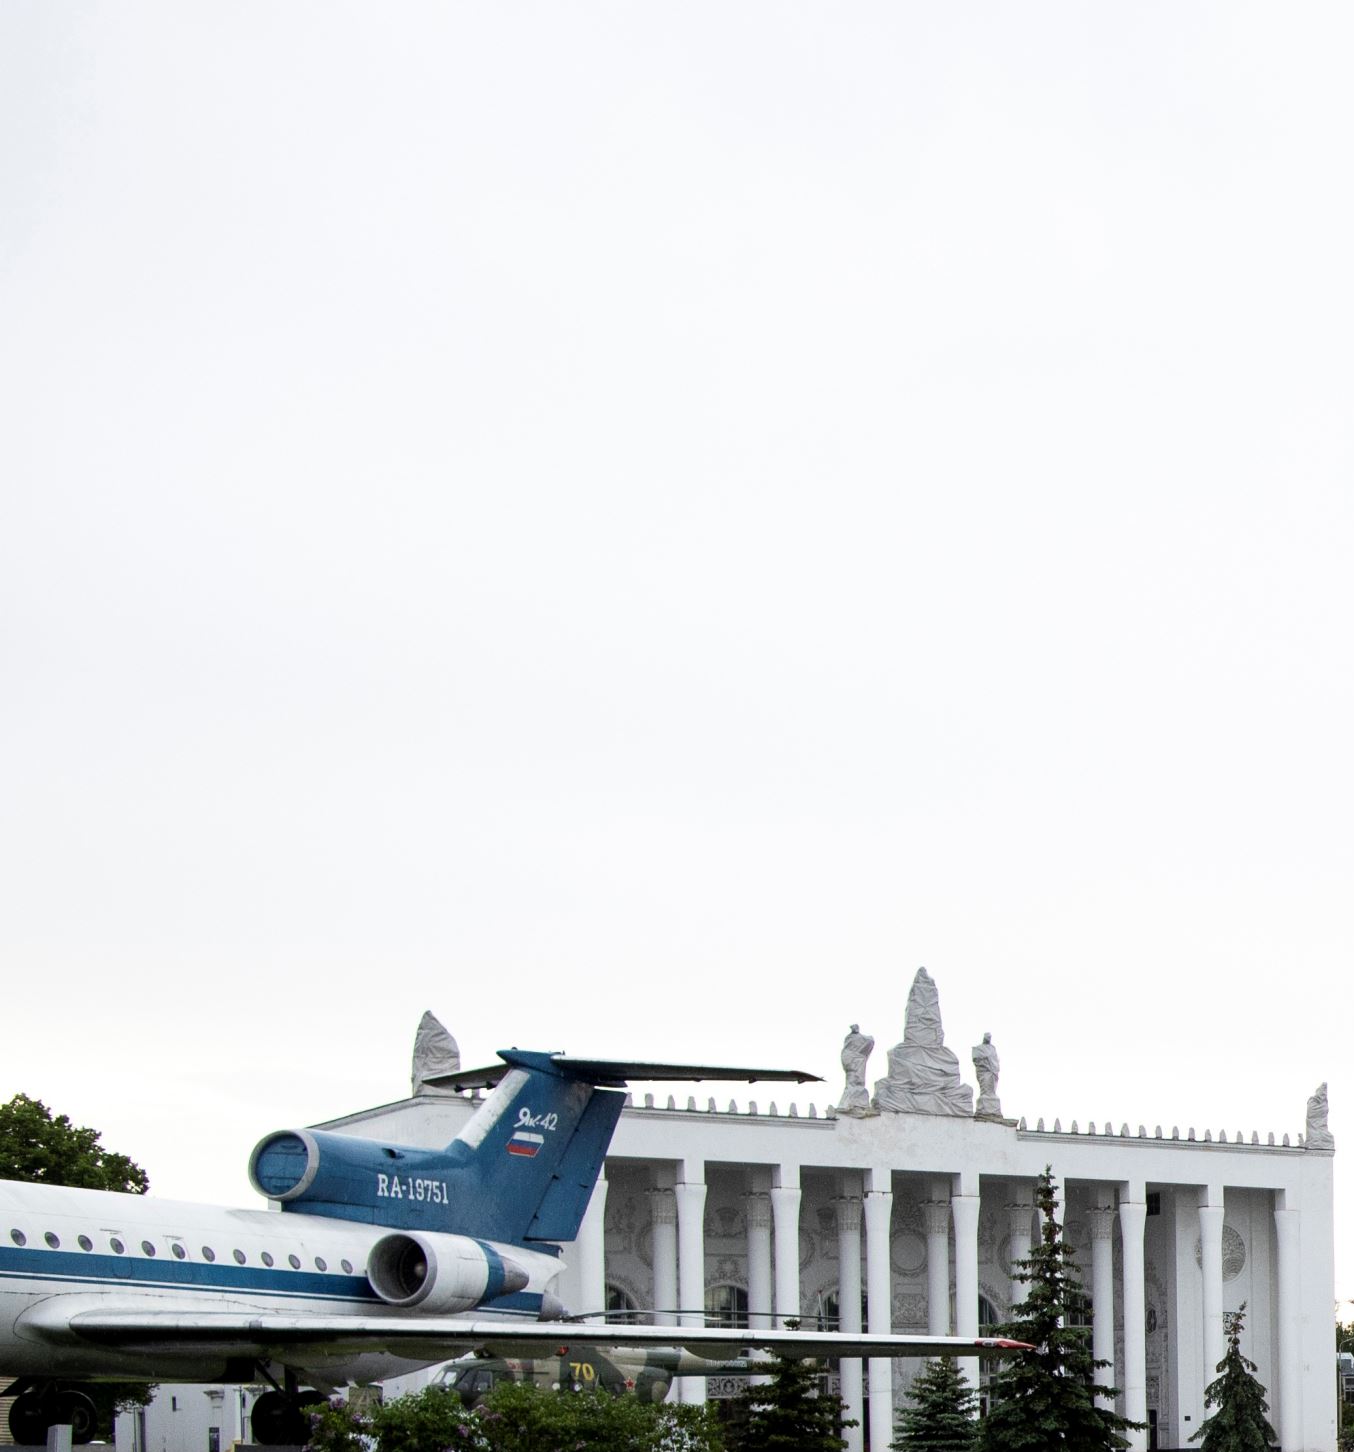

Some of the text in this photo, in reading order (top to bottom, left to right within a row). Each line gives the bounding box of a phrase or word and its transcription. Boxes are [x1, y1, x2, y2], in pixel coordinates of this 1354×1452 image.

[513, 1107, 558, 1131] Як-42
[377, 1173, 449, 1204] RA-19751
[569, 1362, 595, 1381] 70
